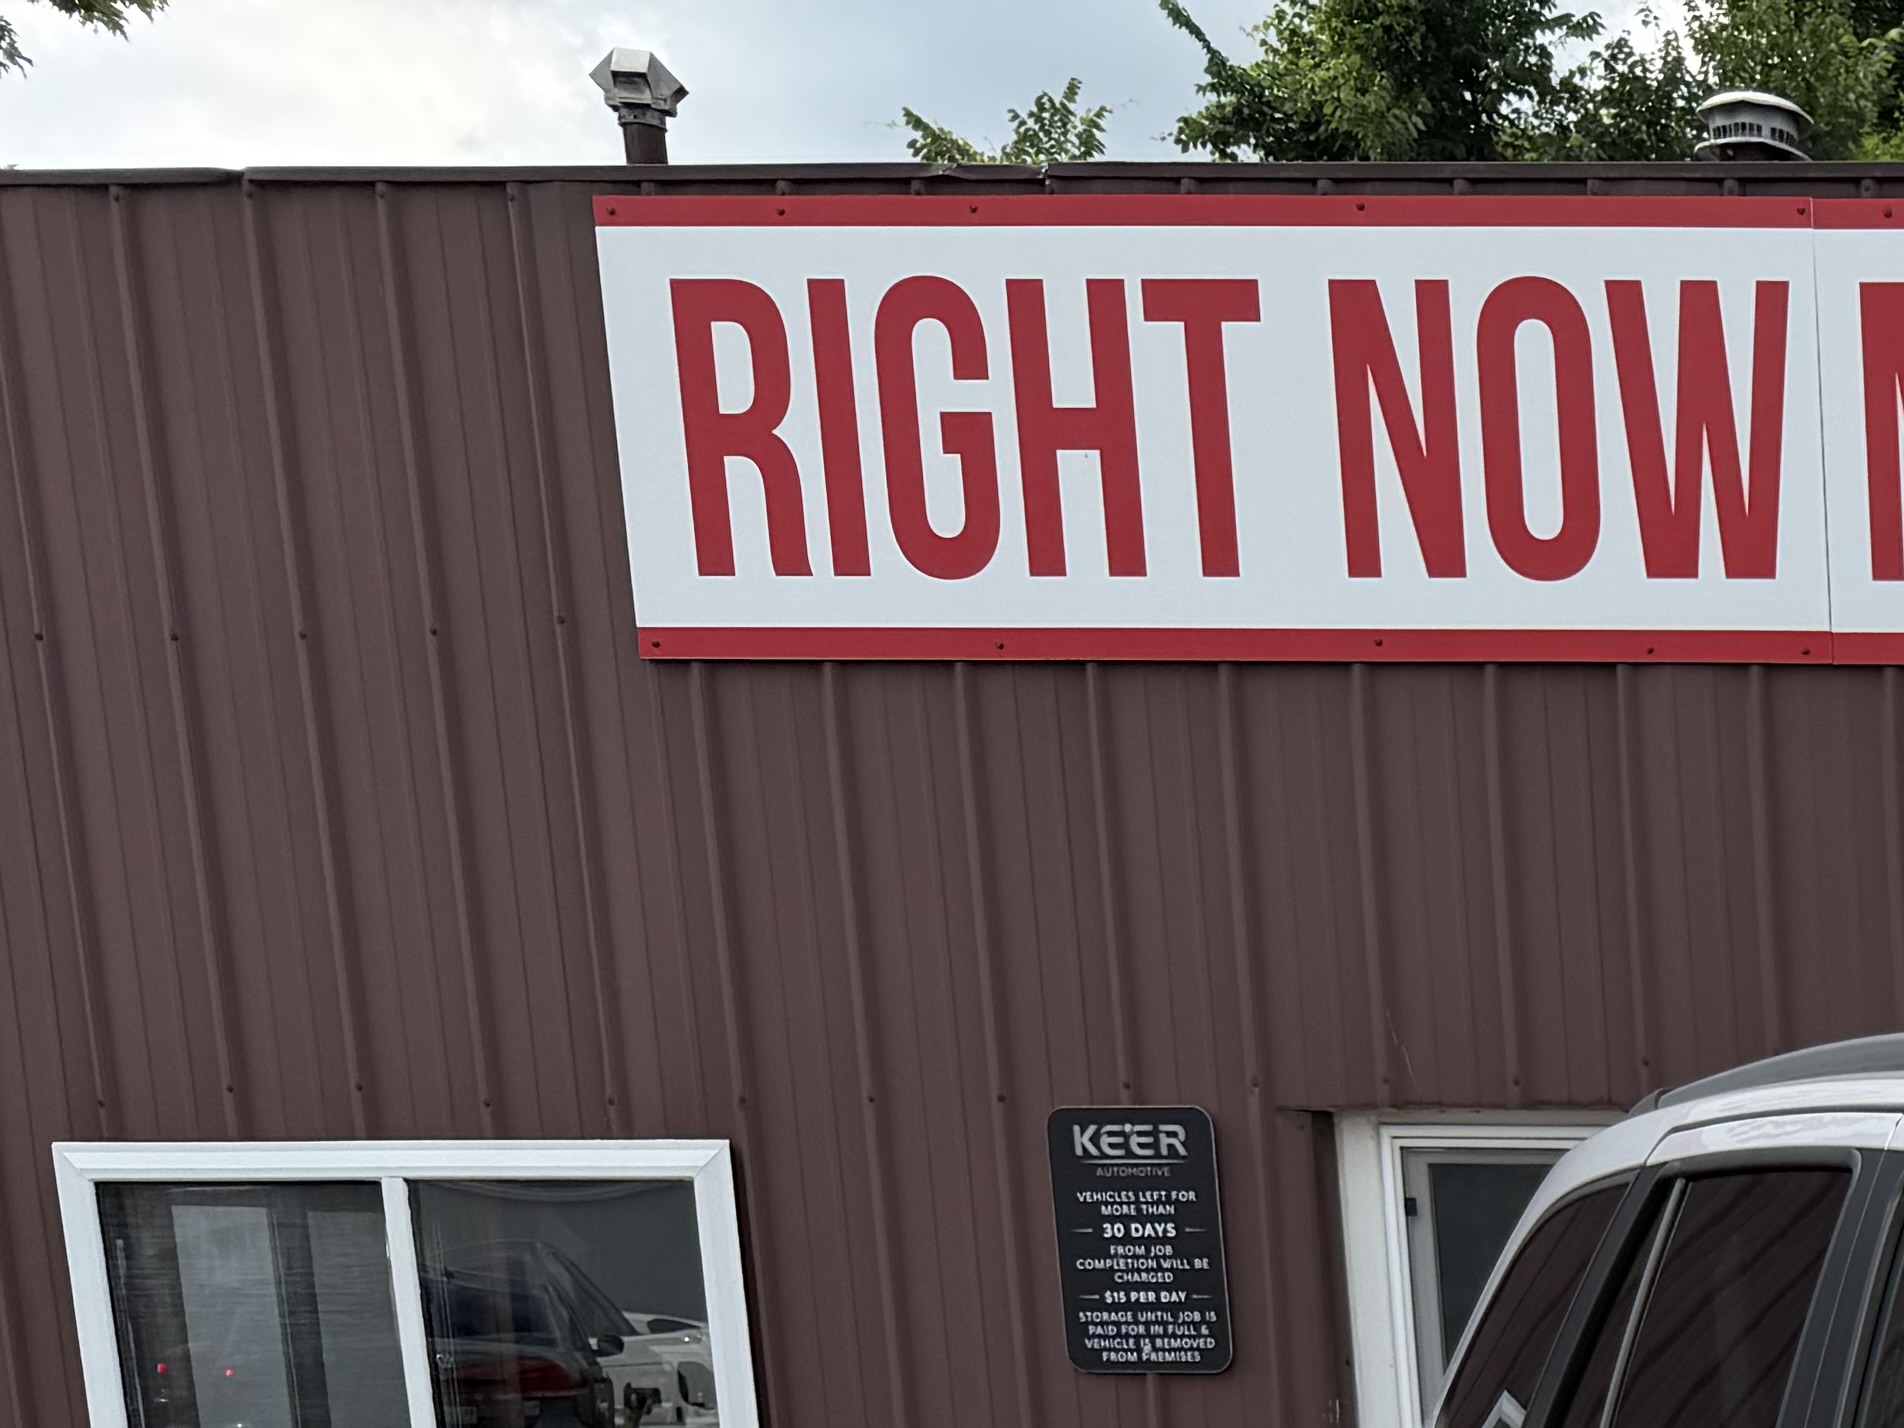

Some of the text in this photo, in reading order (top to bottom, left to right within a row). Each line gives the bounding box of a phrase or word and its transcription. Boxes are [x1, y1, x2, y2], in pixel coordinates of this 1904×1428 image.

[670, 277, 1261, 581] RIGHT
[1328, 277, 1790, 581] NOW
[1073, 1123, 1188, 1156] KEER
[1096, 1166, 1171, 1177] AUTOMOTIVE
[1076, 1191, 1196, 1202] VEHICLES LEFT FOR
[1101, 1204, 1175, 1215] MORE THAN
[1102, 1222, 1177, 1238] 30 DAYS
[1110, 1245, 1174, 1257] FROM JOB
[1076, 1258, 1210, 1270] COMPLETION WILL BE
[1114, 1271, 1174, 1283] CHARGED
[1104, 1290, 1187, 1304] $15 PER DAY
[1079, 1311, 1217, 1324] STORAGE UNTIL JOB IS
[1088, 1324, 1117, 1336] PAID
[1121, 1324, 1146, 1336] FOR
[1150, 1324, 1164, 1336] IN
[1167, 1324, 1197, 1336] FULL
[1084, 1337, 1216, 1349] VEHICLE IS REMOVED
[1102, 1350, 1201, 1363] FROM PREMISES
